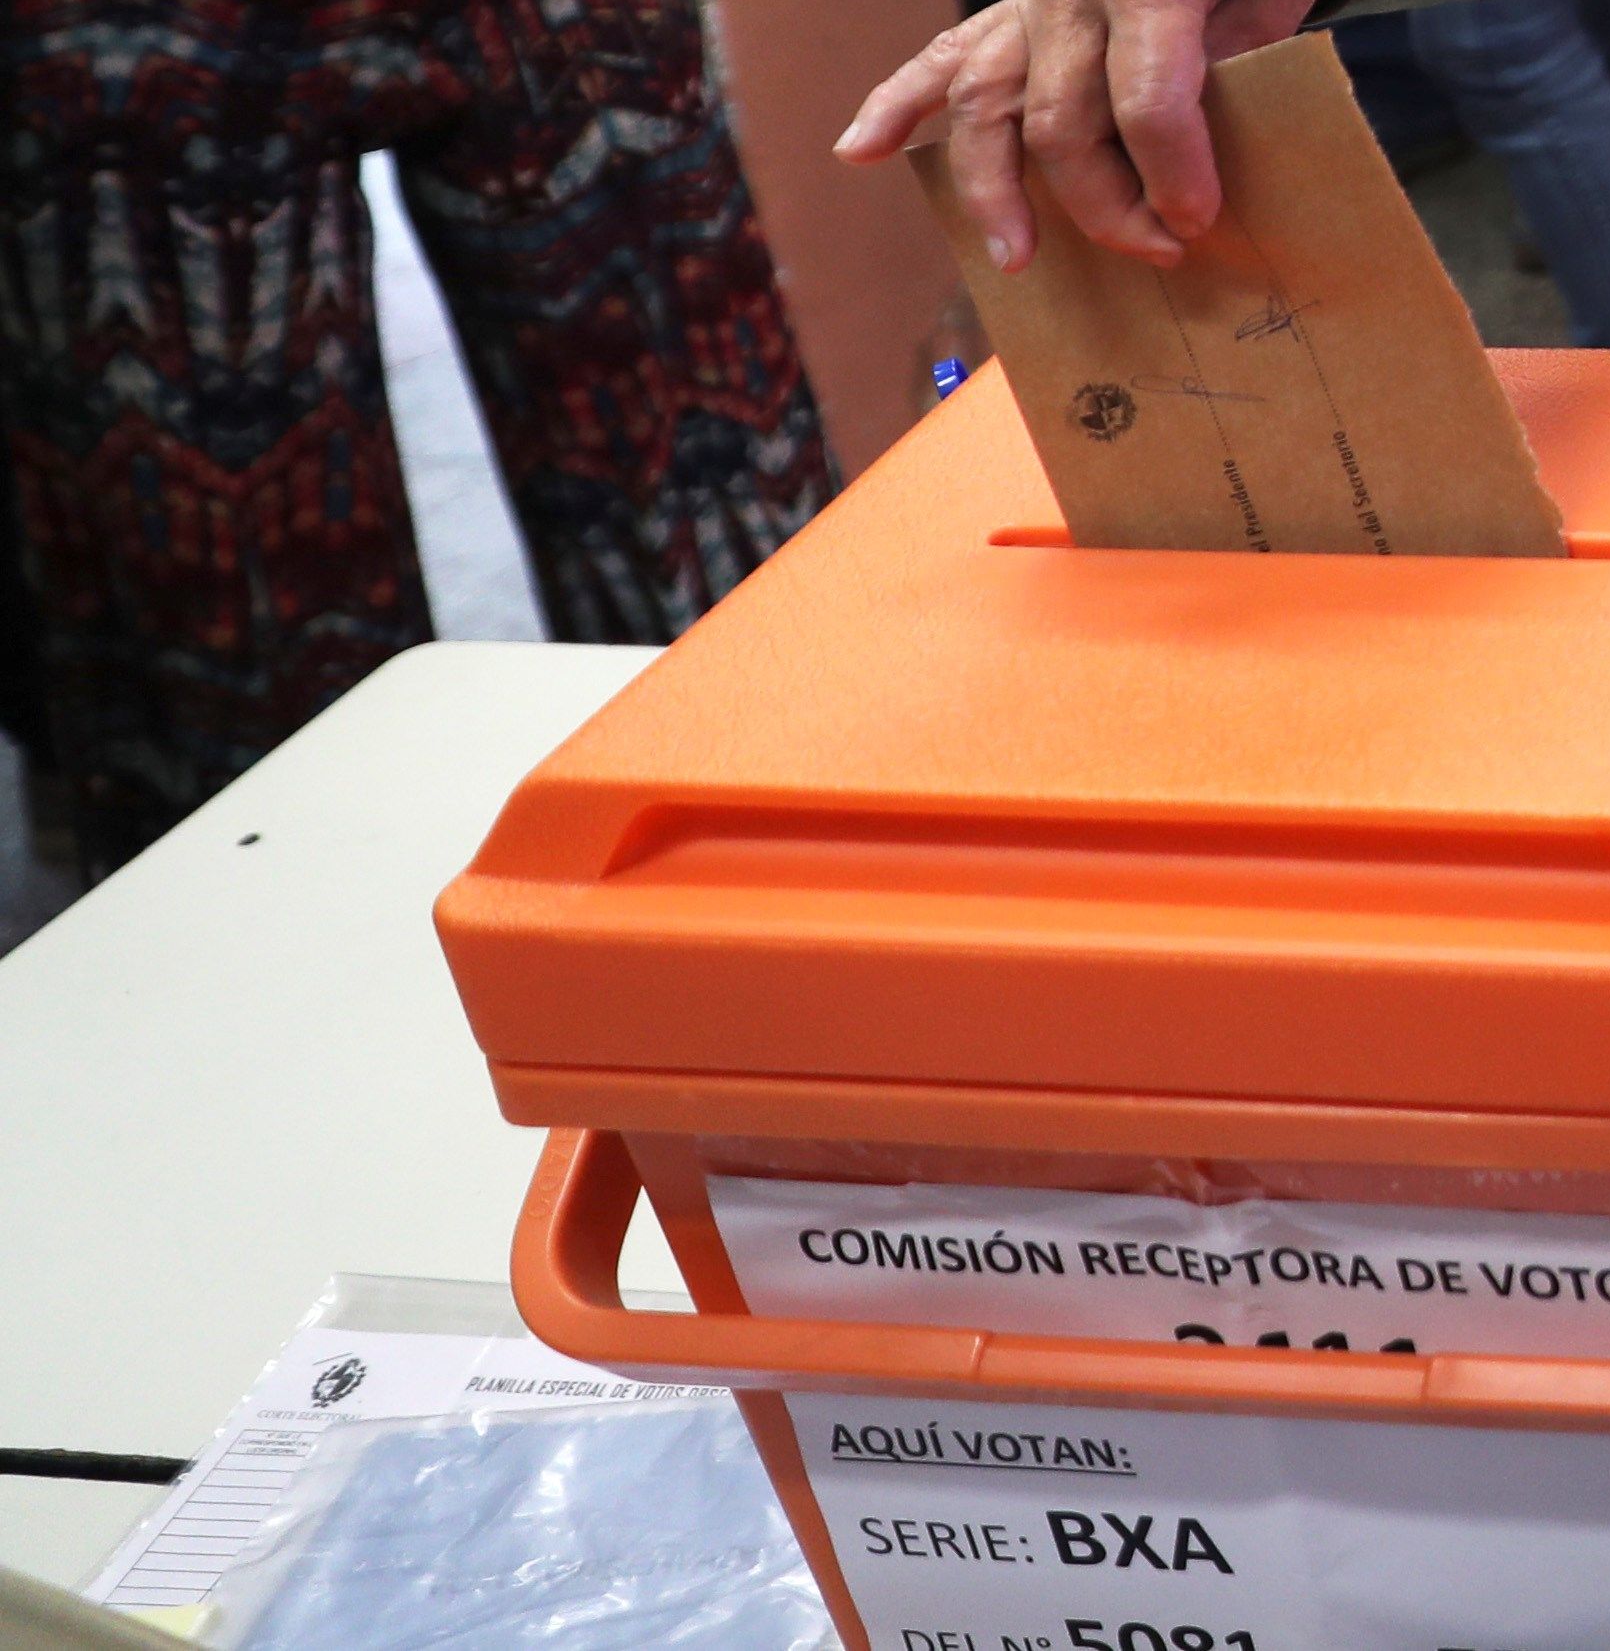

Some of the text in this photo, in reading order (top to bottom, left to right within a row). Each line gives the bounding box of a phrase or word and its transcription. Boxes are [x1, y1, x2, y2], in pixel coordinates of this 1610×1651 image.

[1222, 458, 1264, 537] Presidente
[1332, 430, 1371, 508] Secretario
[1357, 510, 1383, 534] del
[799, 1228, 1065, 1277] COMISIÓN
[1077, 1240, 1385, 1294] RECEPTORA
[1396, 1257, 1469, 1295] DE
[464, 1376, 535, 1395] PLANILLA
[537, 1379, 607, 1398] ESPECIAL
[608, 1382, 634, 1399] DE
[830, 1420, 1132, 1469] AQUÍ VOTAN:
[859, 1510, 1235, 1576] SERIE: BXA
